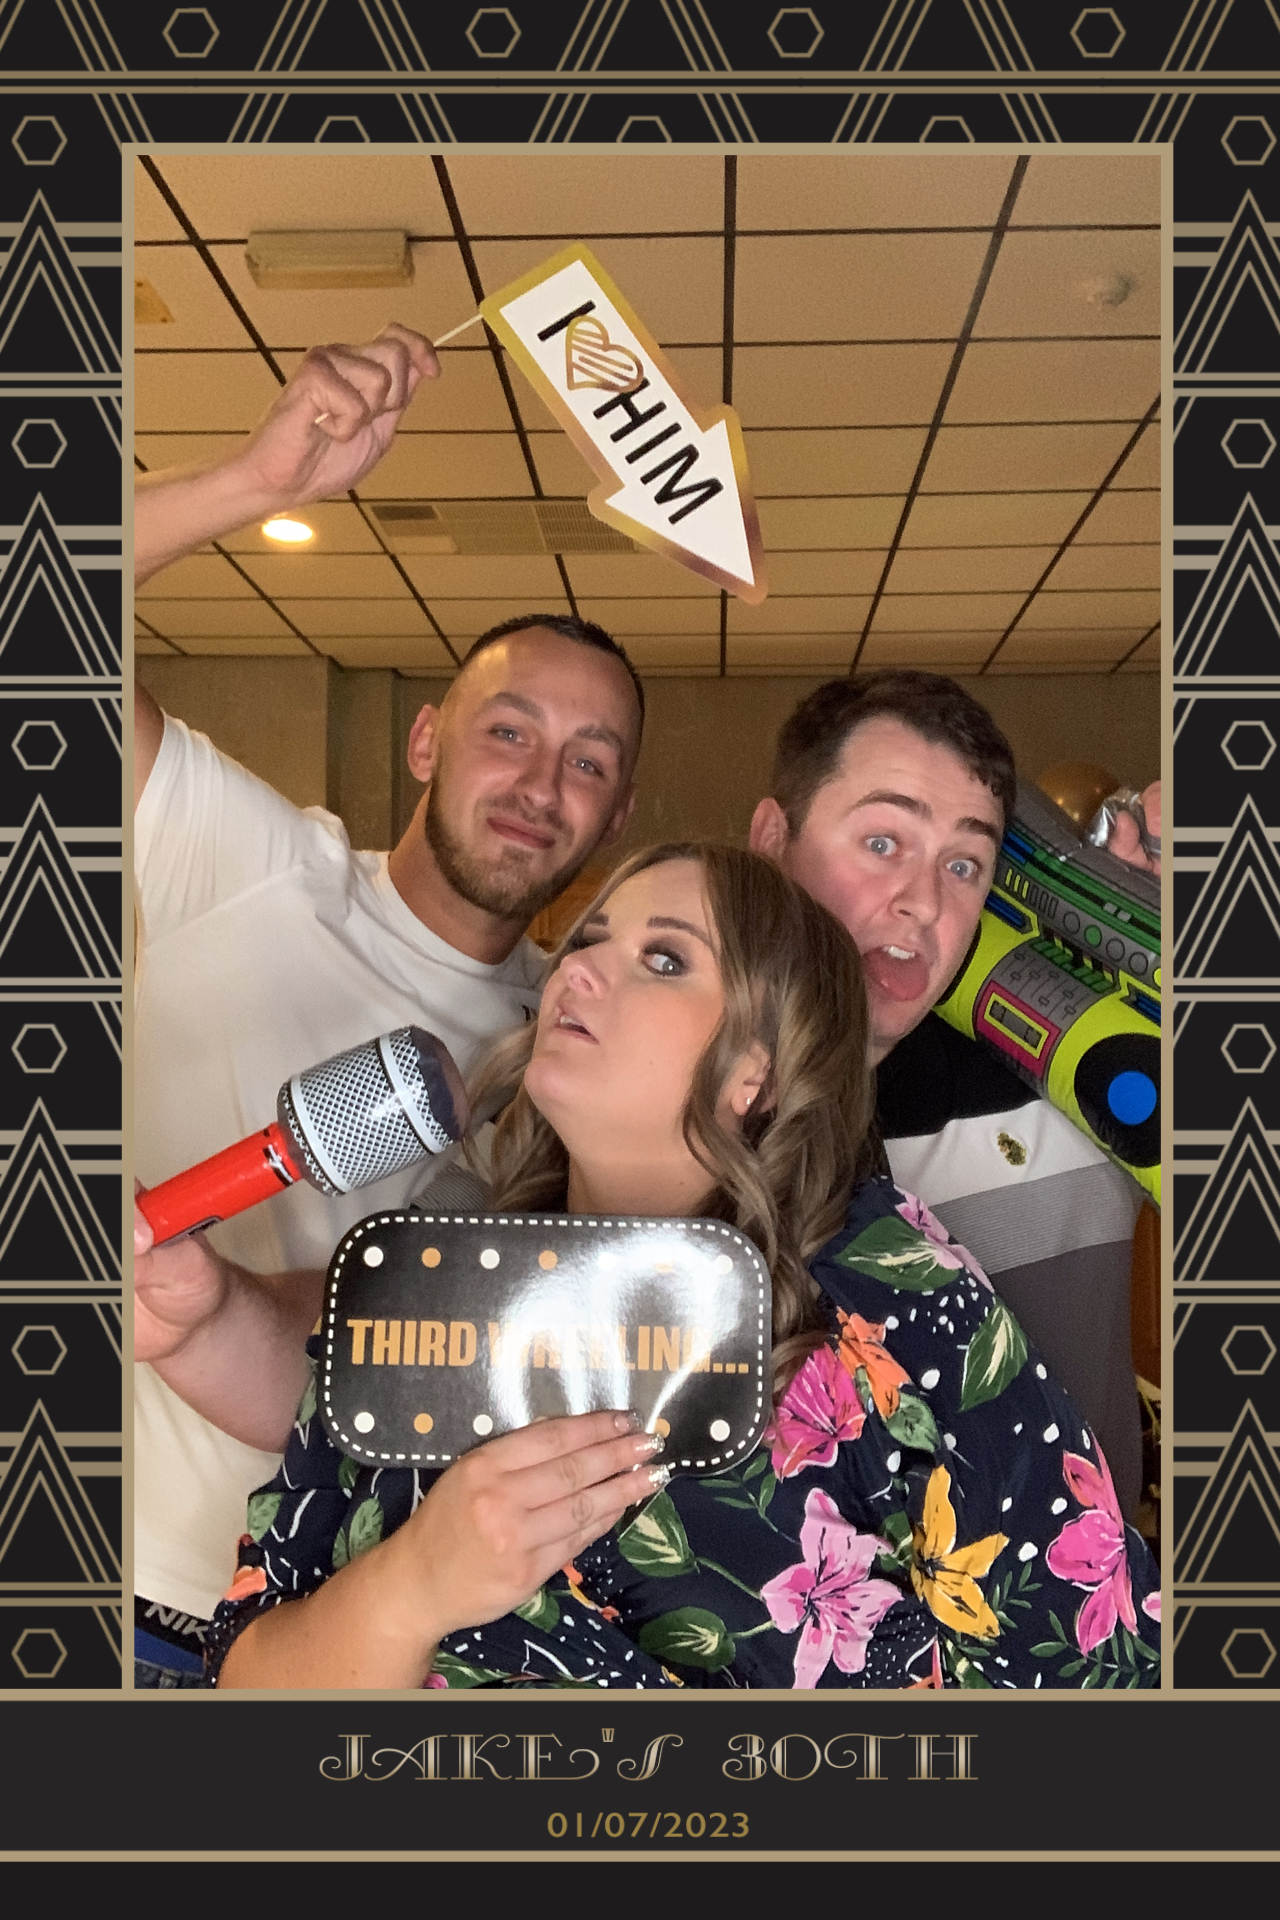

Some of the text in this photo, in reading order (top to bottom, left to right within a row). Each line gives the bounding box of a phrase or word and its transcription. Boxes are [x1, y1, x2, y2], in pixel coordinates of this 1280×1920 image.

[537, 300, 724, 525] I HIM
[347, 1319, 749, 1374] THIRD WHLING...
[144, 1602, 209, 1643] NIK
